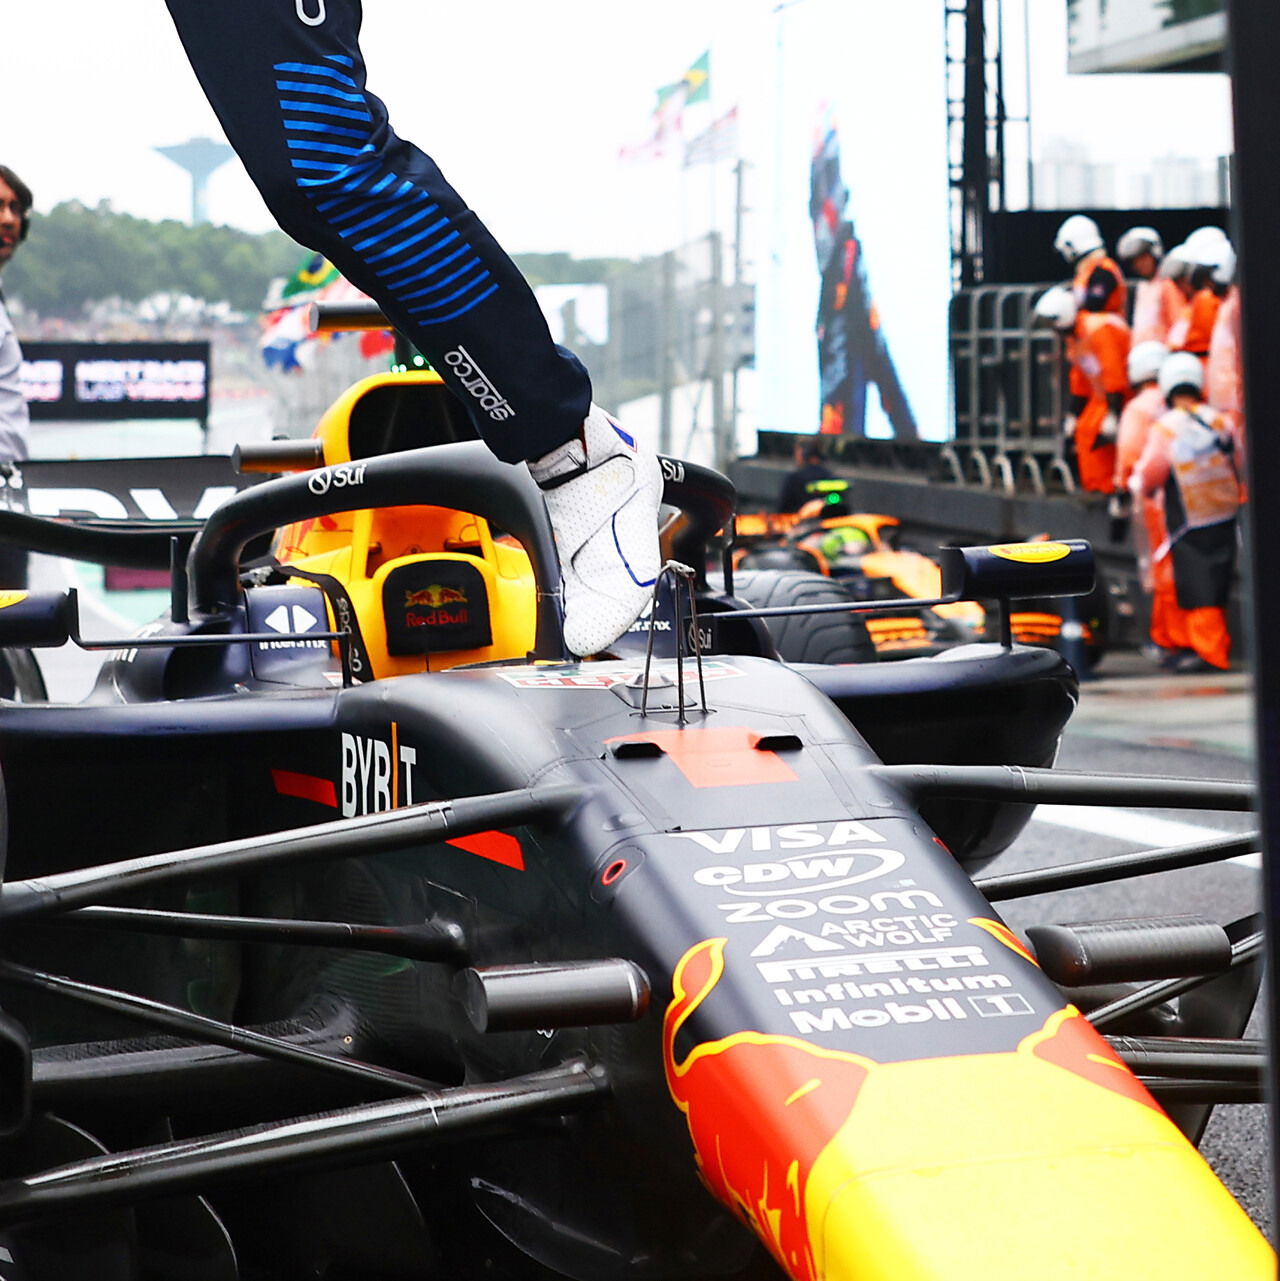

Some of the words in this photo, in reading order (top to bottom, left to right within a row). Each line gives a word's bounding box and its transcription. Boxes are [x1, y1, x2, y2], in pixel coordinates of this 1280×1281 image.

[444, 344, 517, 421] sparco
[341, 721, 417, 818] BYBIT
[668, 820, 887, 854] VISA
[693, 855, 857, 888] CDW
[717, 889, 943, 925] zoom
[820, 913, 959, 937] ARCTIC
[841, 926, 954, 949] WOLF
[755, 945, 991, 985] PIRELLI
[789, 995, 968, 1035] Mobil
